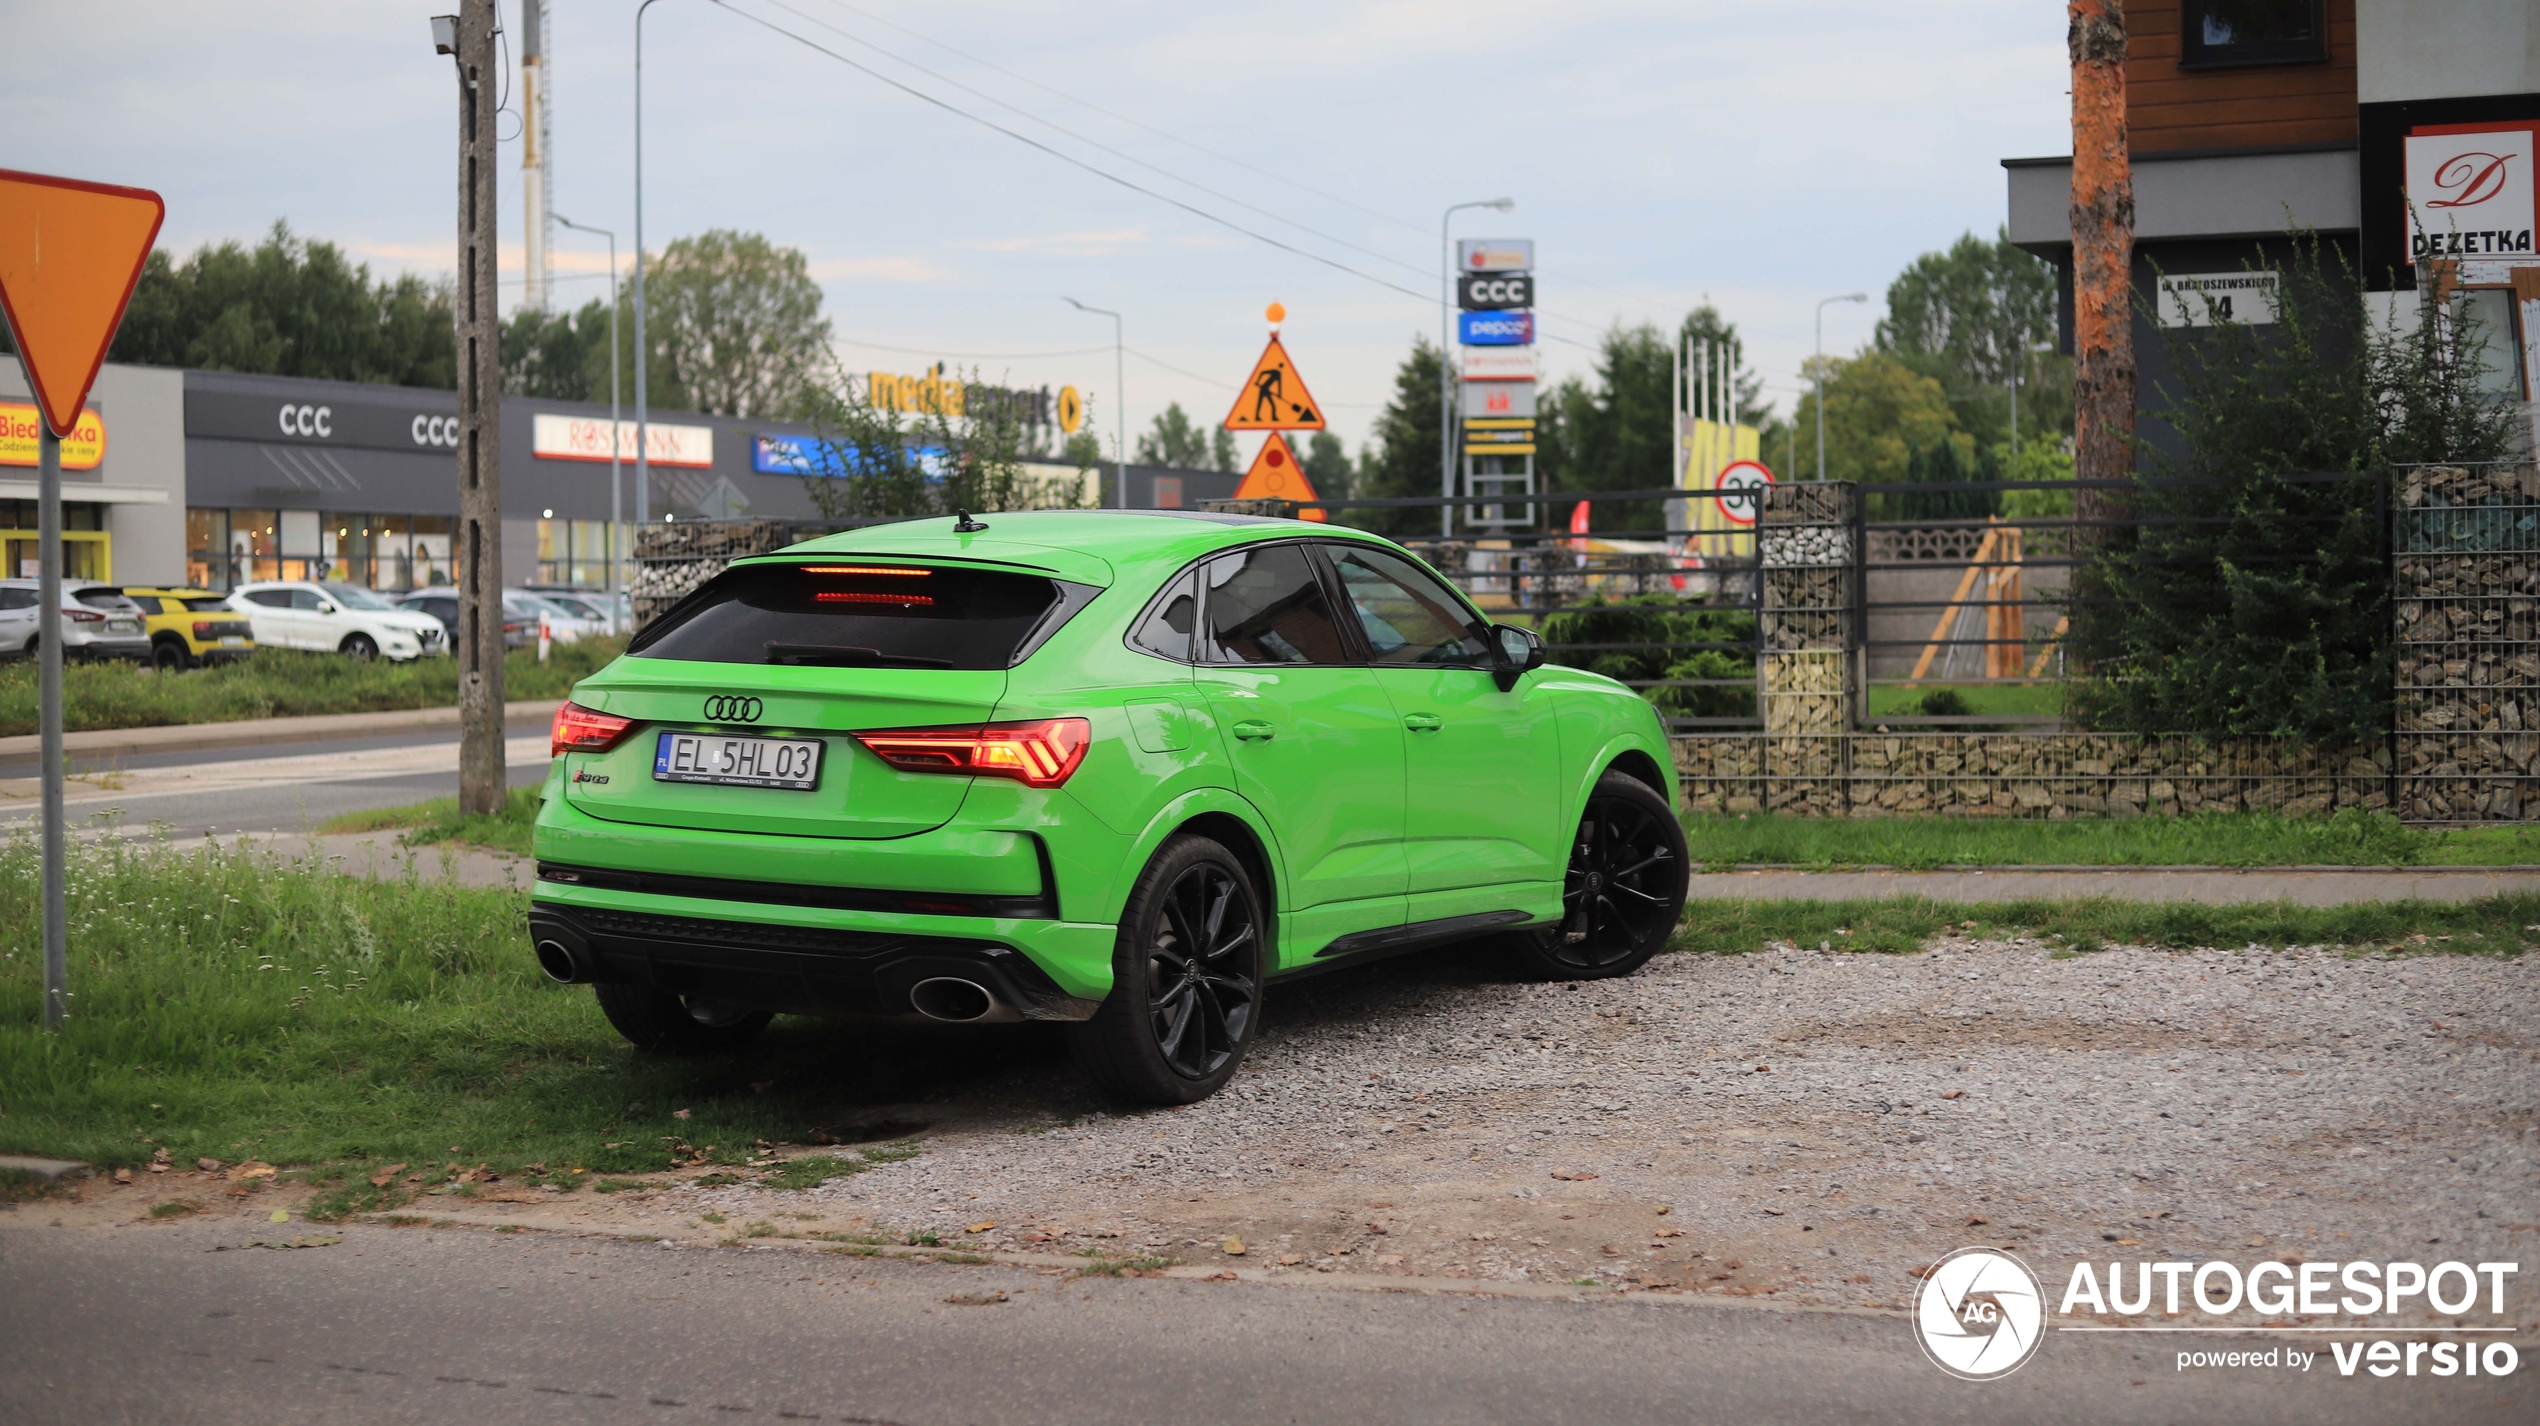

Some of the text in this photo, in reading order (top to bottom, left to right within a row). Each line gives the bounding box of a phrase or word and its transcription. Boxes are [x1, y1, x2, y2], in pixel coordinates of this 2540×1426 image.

[2426, 152, 2518, 208] D
[2412, 229, 2531, 256] DEZETKA
[1469, 280, 1526, 303] CCC
[0, 414, 97, 443] Biedka
[279, 404, 332, 438] CCC
[411, 414, 459, 447] CCC
[657, 757, 668, 767] PL
[674, 738, 811, 779] EL 5HL03
